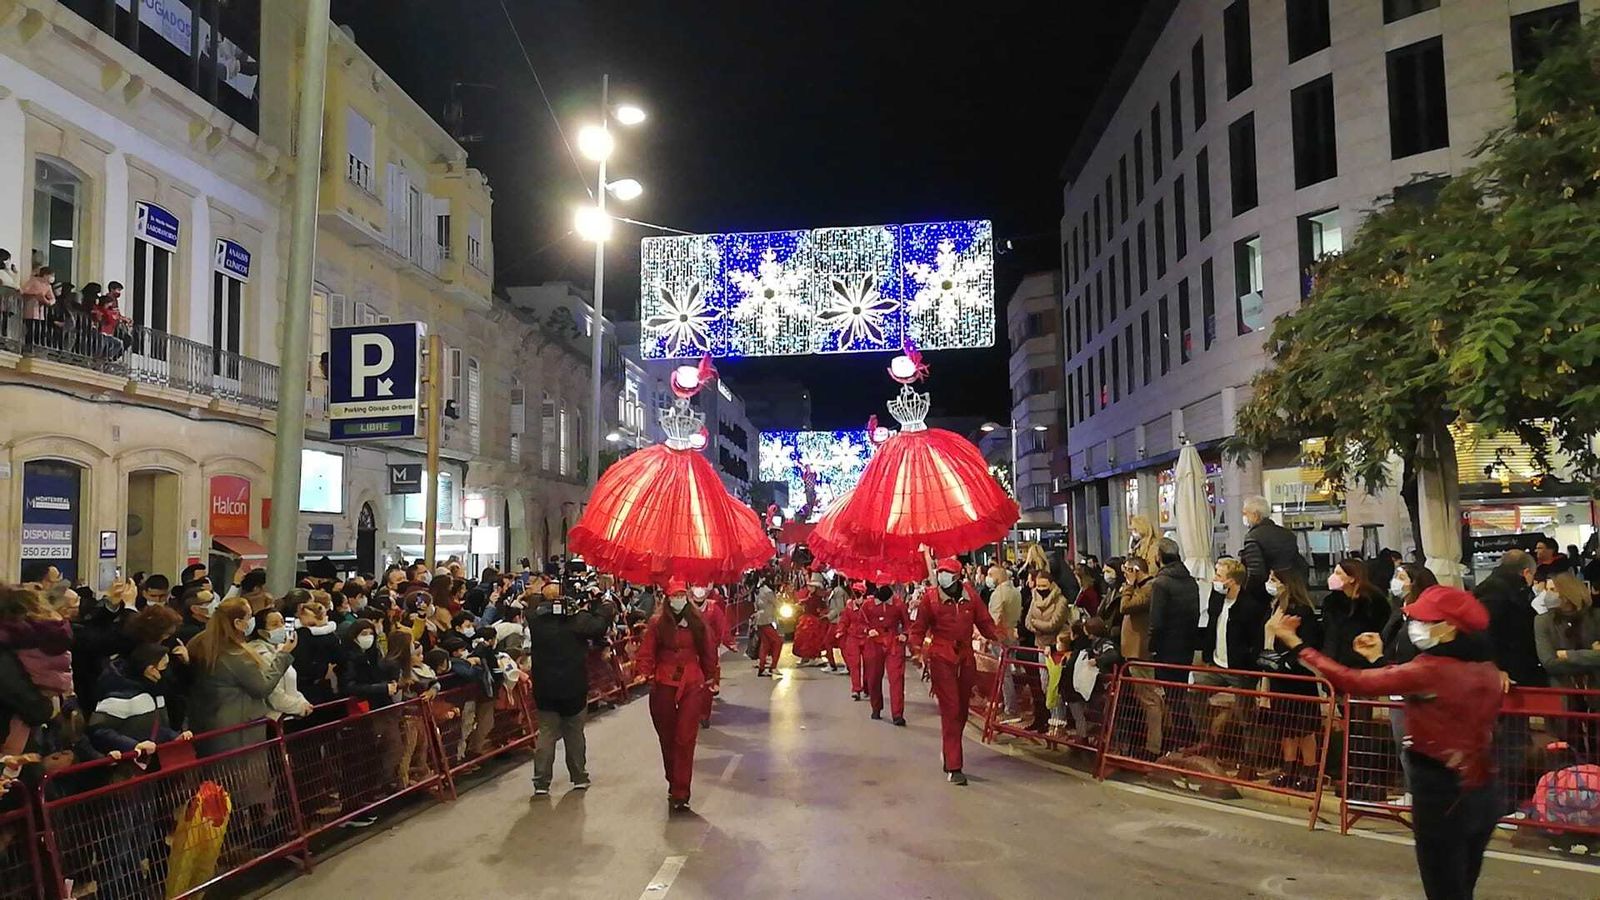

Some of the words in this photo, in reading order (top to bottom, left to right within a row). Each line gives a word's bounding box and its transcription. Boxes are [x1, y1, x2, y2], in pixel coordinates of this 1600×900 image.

[142, 0, 191, 37] OGADOS
[351, 333, 394, 397] P
[344, 406, 367, 414] Parking
[360, 422, 389, 432] LIBRE
[23, 529, 71, 540] DISPONIBLE
[23, 547, 40, 557] 950
[40, 547, 50, 557] 27
